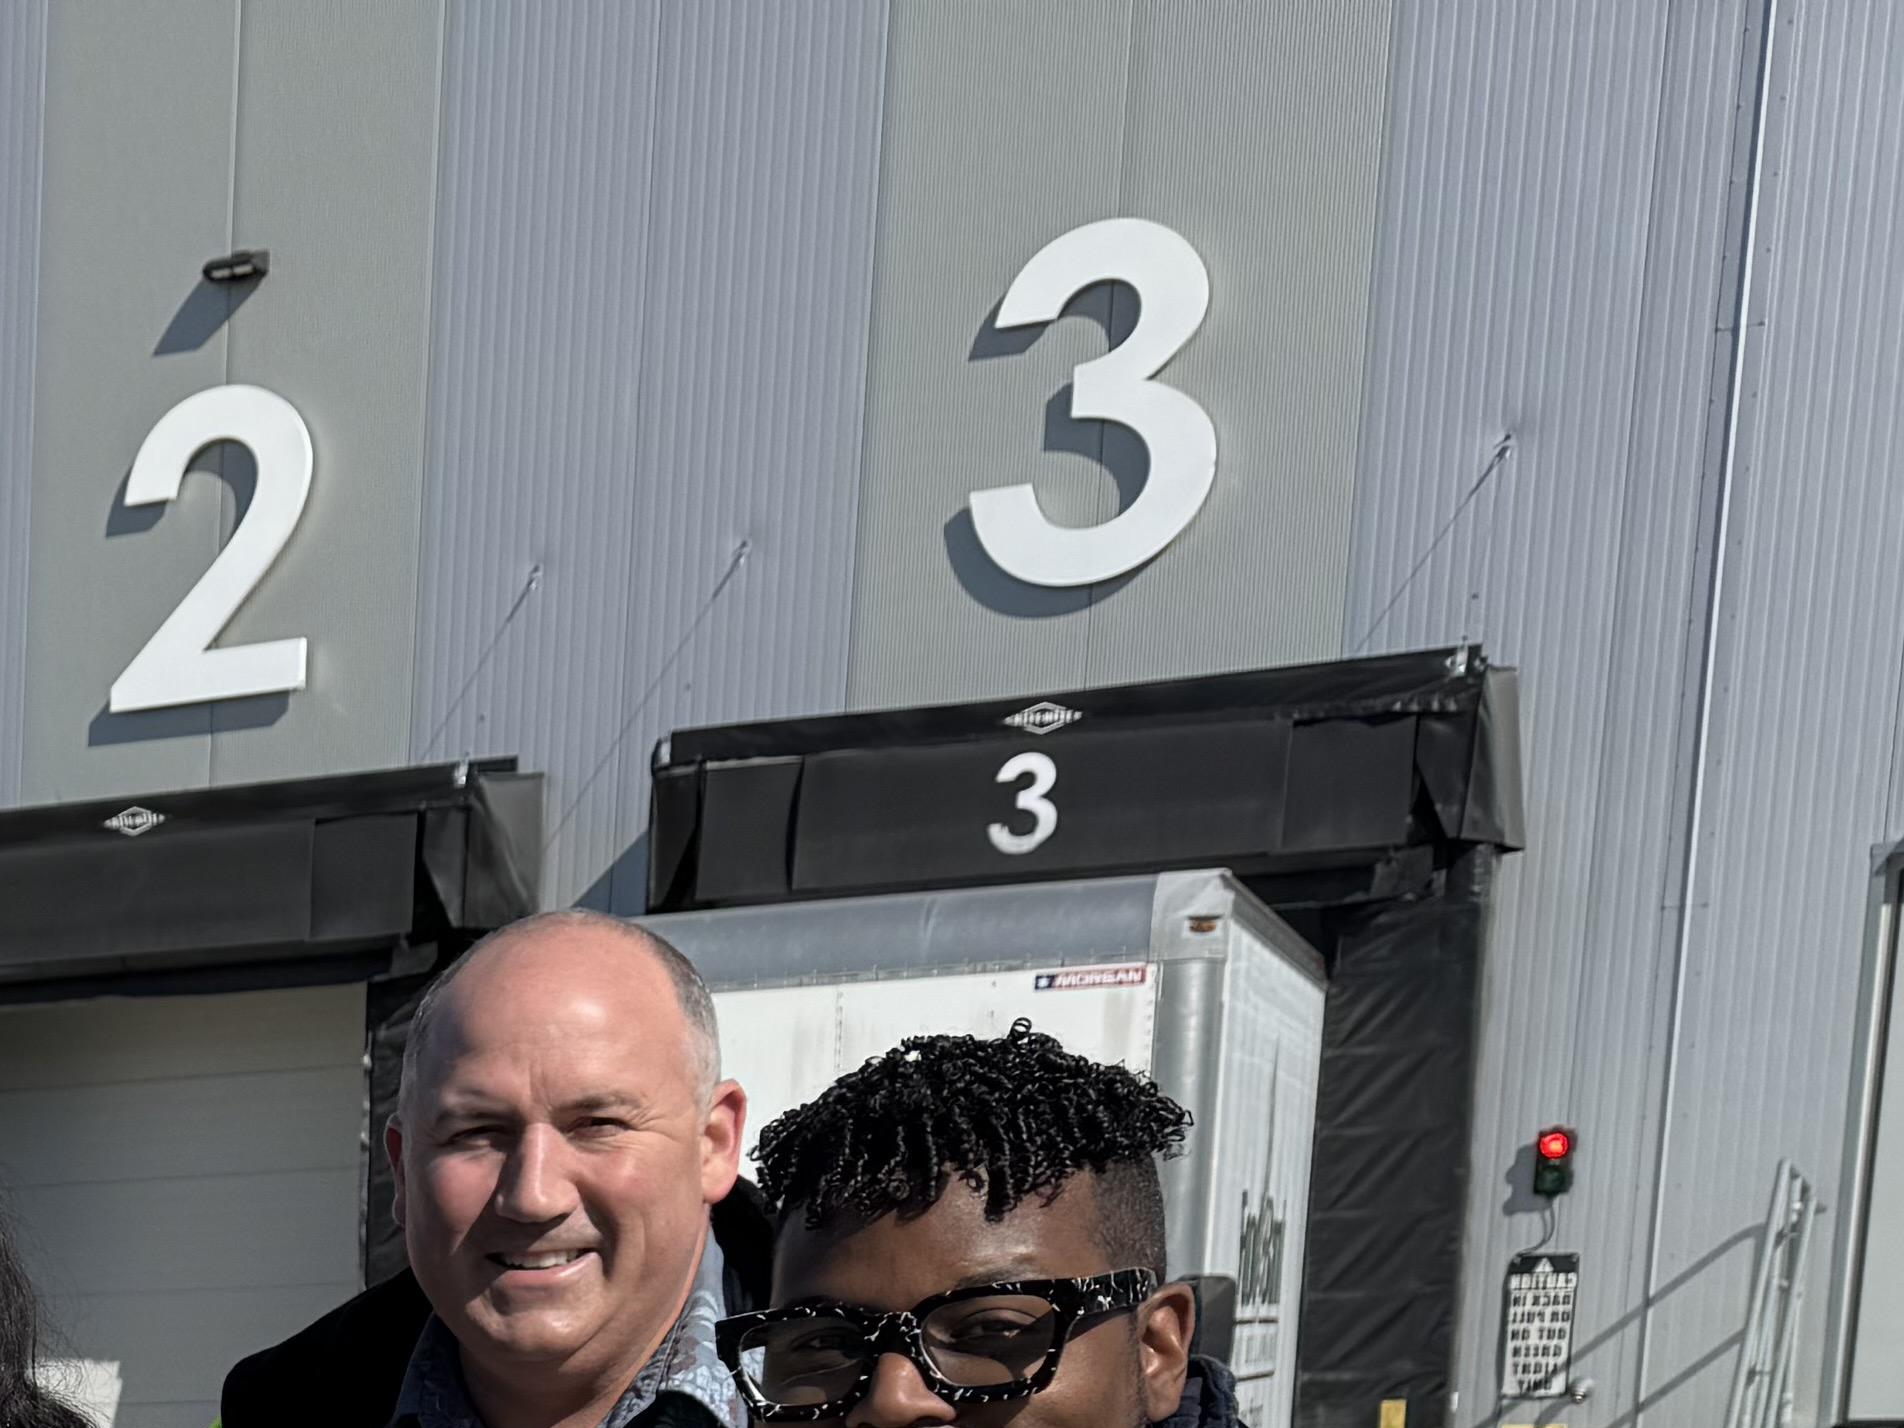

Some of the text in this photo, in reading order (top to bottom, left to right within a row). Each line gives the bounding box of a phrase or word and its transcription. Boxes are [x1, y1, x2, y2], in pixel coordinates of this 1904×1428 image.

[110, 384, 314, 713] 2
[968, 217, 1217, 588] 3
[988, 751, 1058, 855] 3
